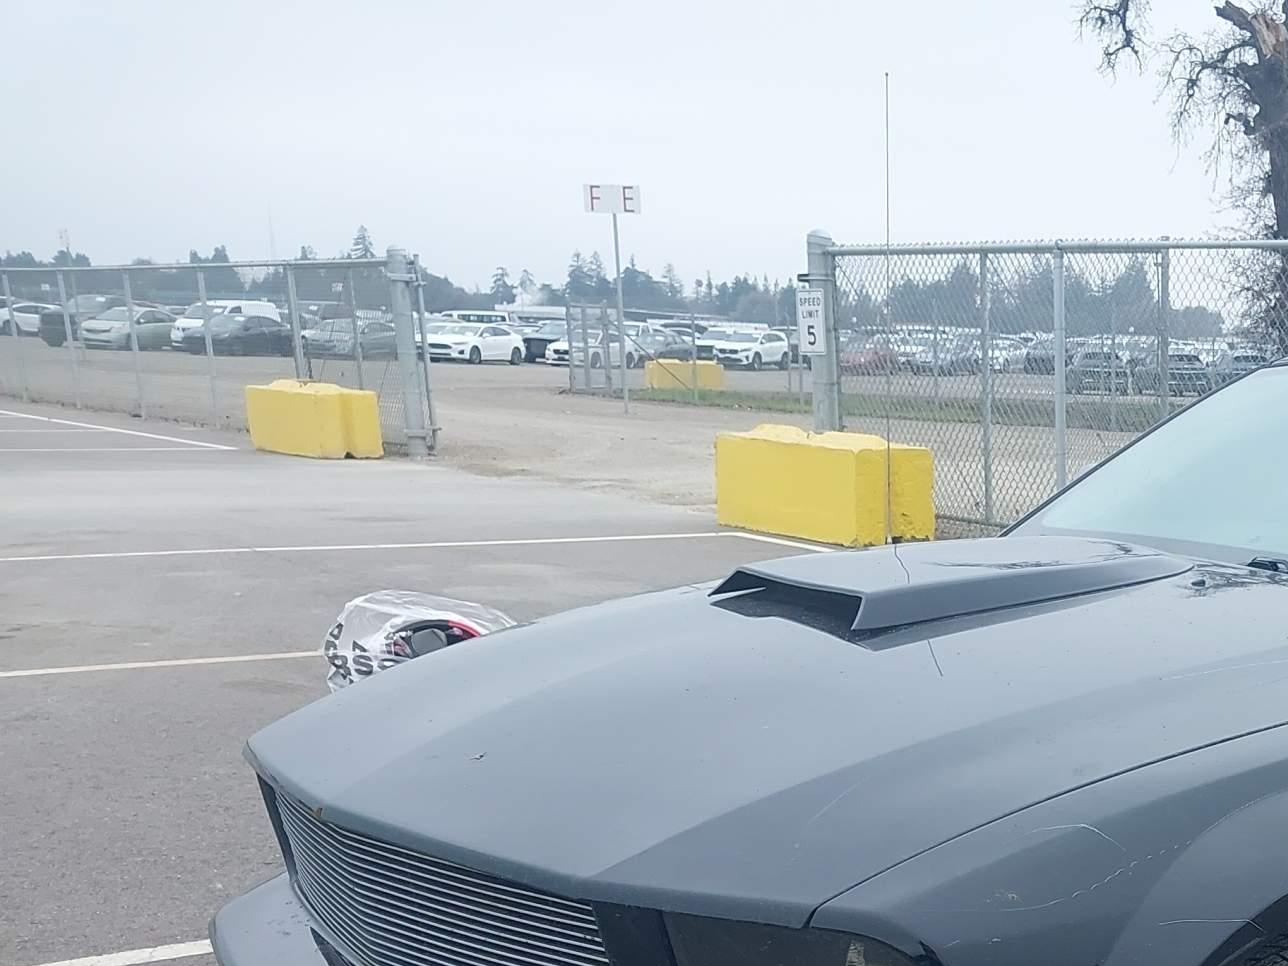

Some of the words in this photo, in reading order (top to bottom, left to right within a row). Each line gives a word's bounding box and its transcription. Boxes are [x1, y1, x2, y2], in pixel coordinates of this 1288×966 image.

[589, 185, 601, 211] F
[622, 186, 635, 212] E
[799, 297, 821, 306] SPEED
[801, 310, 819, 319] LIMIT
[807, 325, 817, 346] 5
